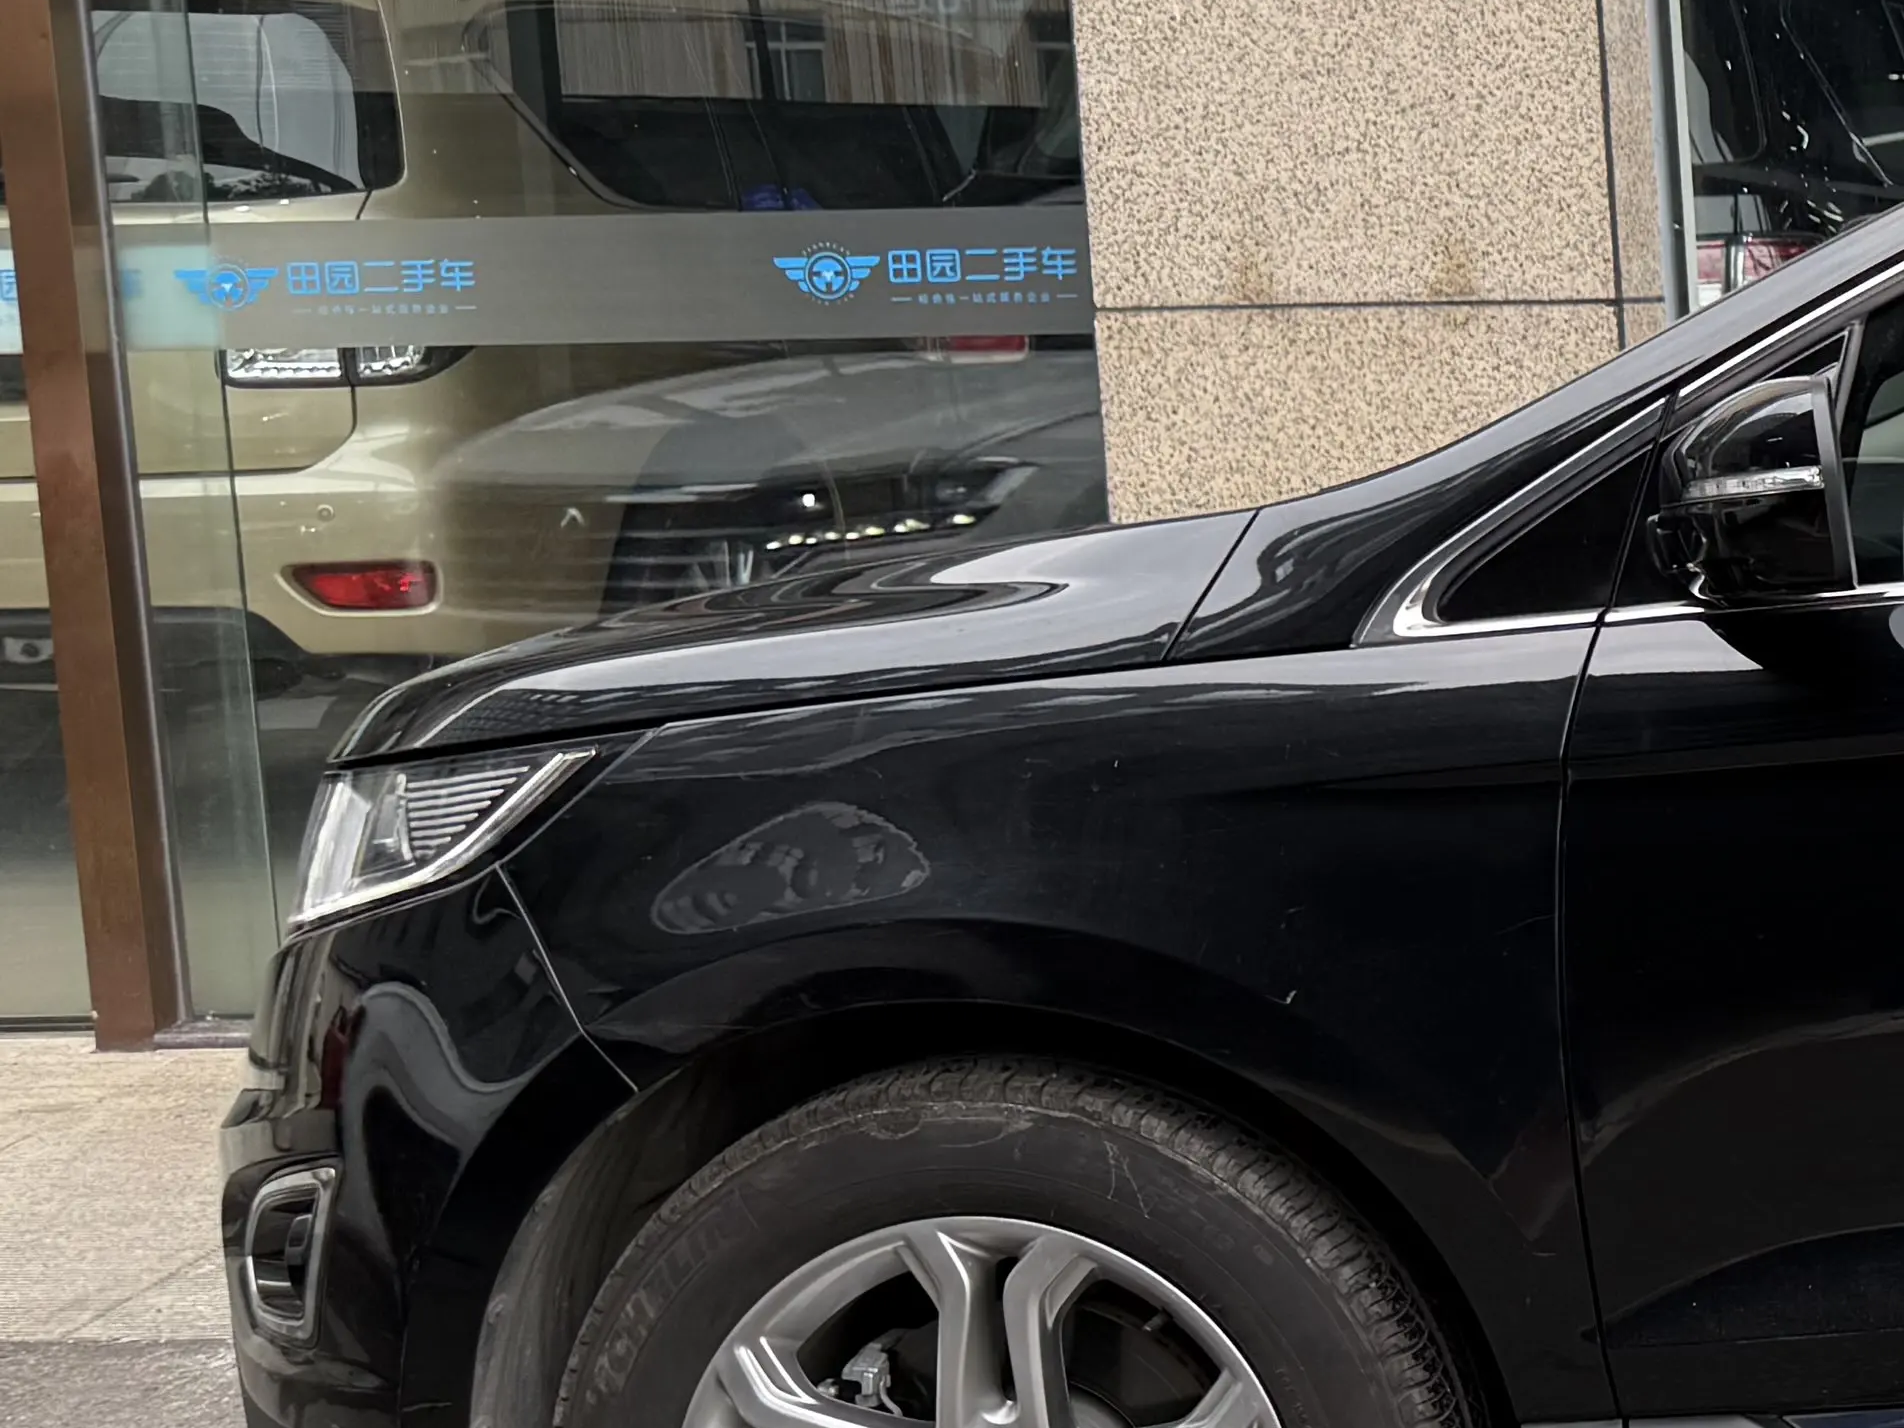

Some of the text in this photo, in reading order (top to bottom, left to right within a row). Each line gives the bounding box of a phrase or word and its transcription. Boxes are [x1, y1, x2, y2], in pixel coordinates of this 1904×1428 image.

[286, 258, 476, 295] 田园二手车
[887, 246, 1078, 283] 田园二手车
